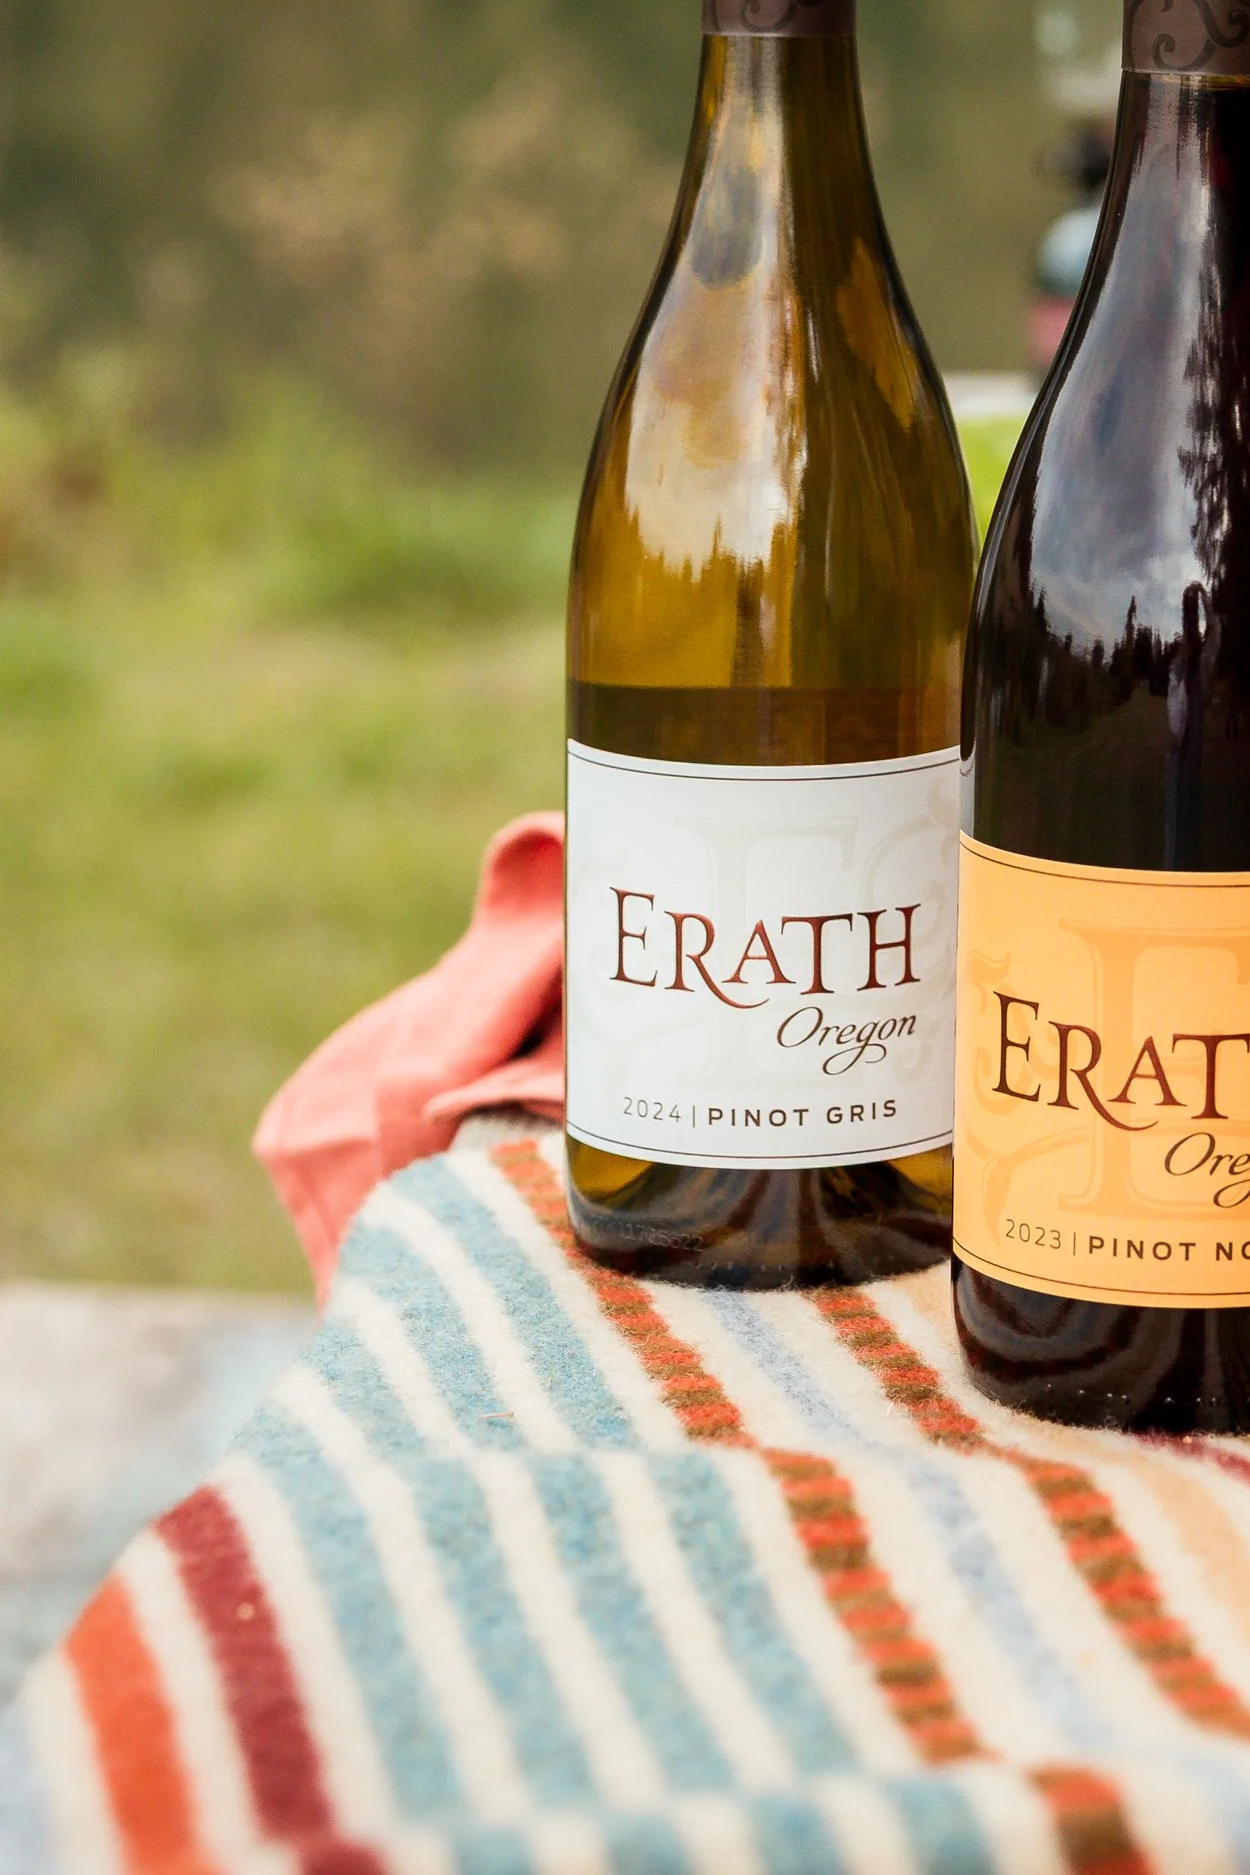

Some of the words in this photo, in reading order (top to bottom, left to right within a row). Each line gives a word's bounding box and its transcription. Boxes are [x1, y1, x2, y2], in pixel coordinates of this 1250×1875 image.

[609, 886, 921, 1009] ERATH
[776, 1006, 917, 1076] Oregon
[622, 1097, 682, 1122] 2024
[708, 1107, 810, 1127] PINOT
[826, 1099, 897, 1125] GRIS
[1004, 1218, 1062, 1250] 2023
[1088, 1235, 1196, 1262] PINOT
